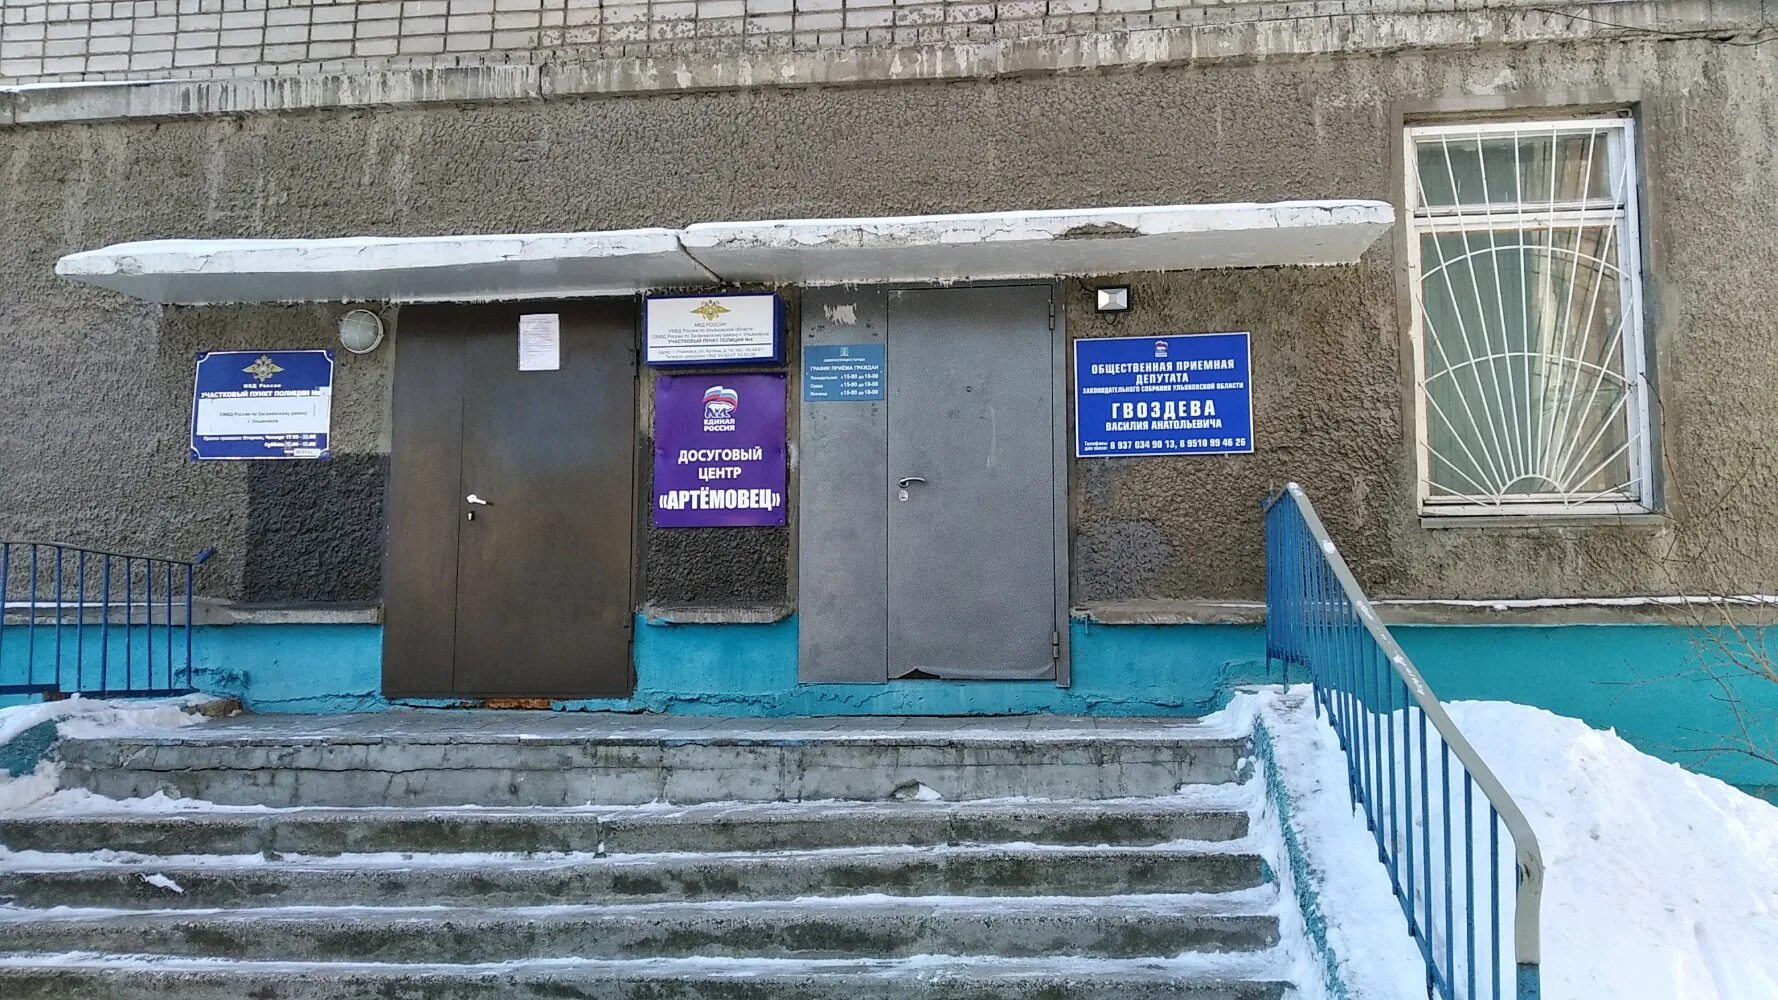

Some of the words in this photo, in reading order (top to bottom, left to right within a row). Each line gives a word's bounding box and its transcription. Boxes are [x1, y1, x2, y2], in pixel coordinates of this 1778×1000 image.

[1091, 362, 1172, 375] ОБЩЕСТВЕННАЯ
[1176, 359, 1234, 371] ПРИЕМНАЯ
[1136, 373, 1189, 385] ДЕПУТАТА
[201, 390, 248, 398] УЧАСТКОВЫЙ
[1083, 386, 1140, 394] ЗАКОНОДАТЕЛЬНОГО
[1173, 383, 1215, 391] УЛЬЯНОВСКОЙ
[1112, 400, 1216, 420] ГВОЗДЕВА
[1106, 420, 1148, 431] ВАСИЛИЯ
[1152, 419, 1222, 430] АНАТОЛЬЕВИЧА
[1110, 441, 1115, 449] 8
[1117, 441, 1131, 449] 937
[1134, 440, 1149, 448] 034
[1151, 440, 1162, 448] 90
[1164, 440, 1177, 449] 13,
[1209, 439, 1220, 447] 99
[1235, 438, 1246, 446] 26
[678, 446, 762, 464] ДОСУГОВЫЙ
[698, 467, 742, 481] ЦЕНТР
[659, 486, 780, 510] «АРТЁМОВЕЦ»
